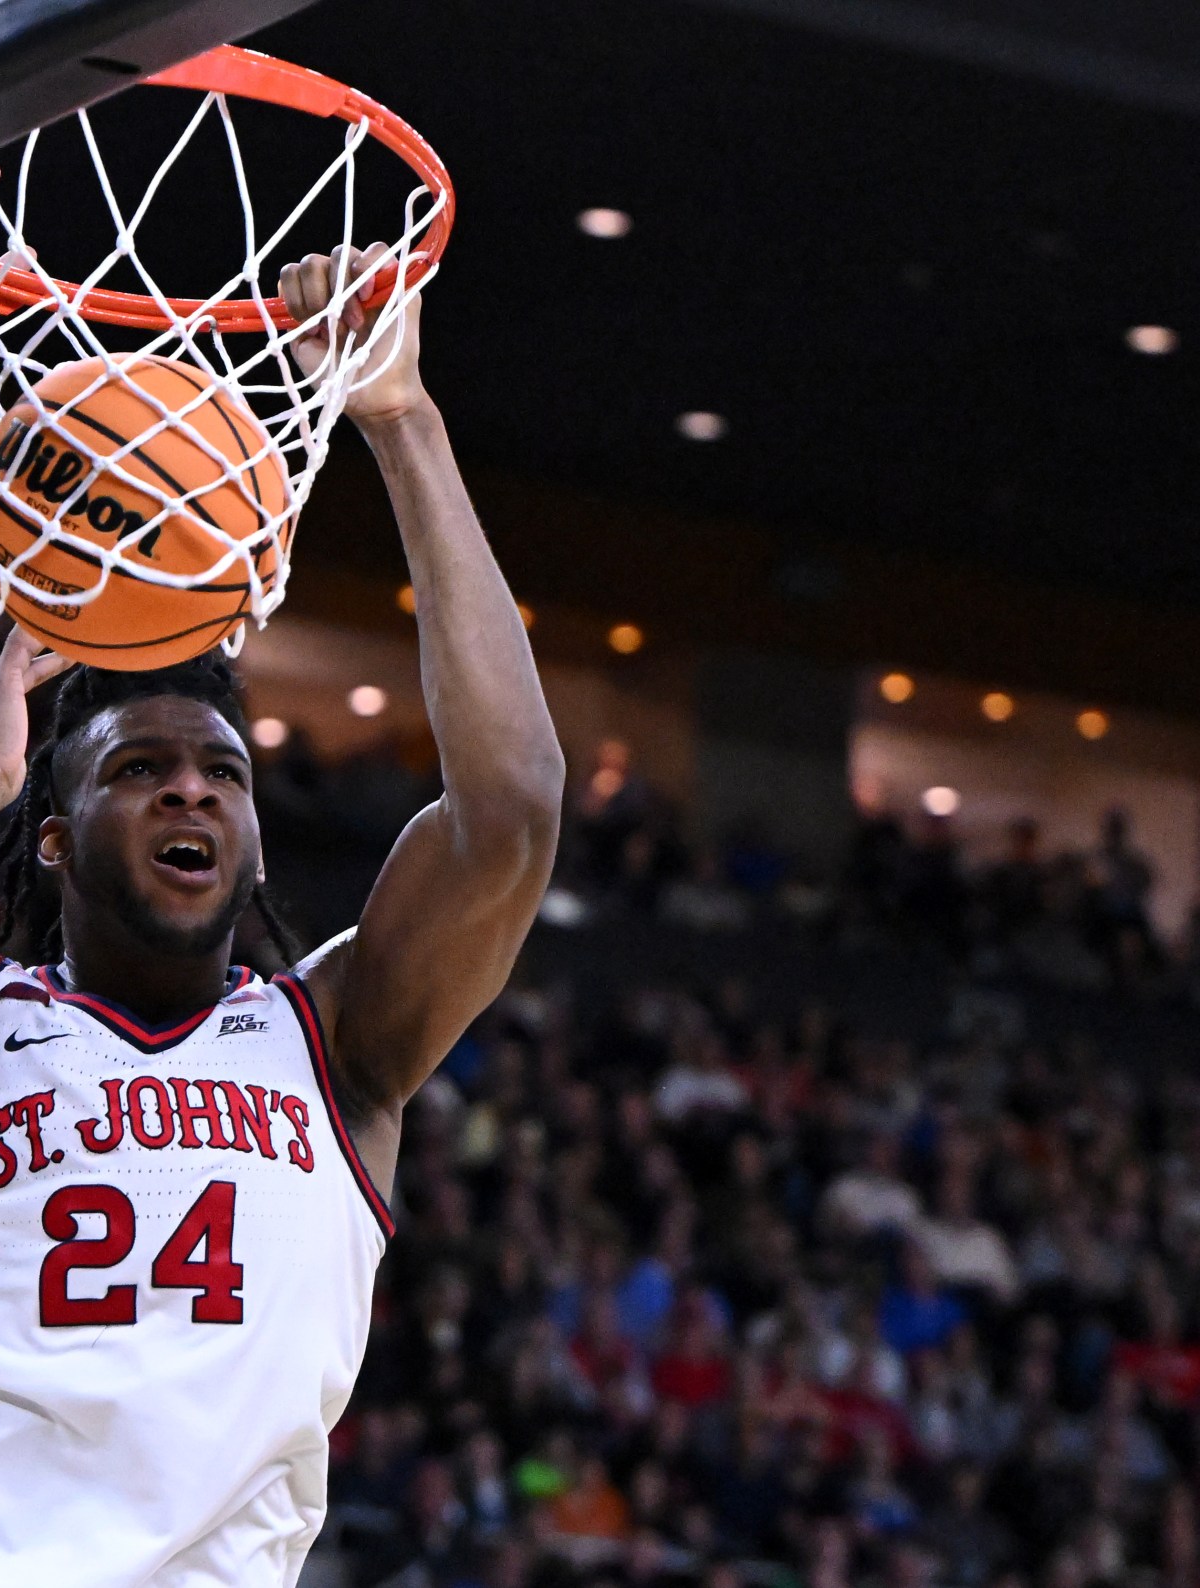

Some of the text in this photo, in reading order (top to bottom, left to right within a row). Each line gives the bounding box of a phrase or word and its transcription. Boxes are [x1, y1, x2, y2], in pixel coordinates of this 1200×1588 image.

[219, 1021, 268, 1033] EAST
[221, 1013, 256, 1025] BIG
[75, 1075, 315, 1174] JOHN'S
[39, 1180, 244, 1328] 24
